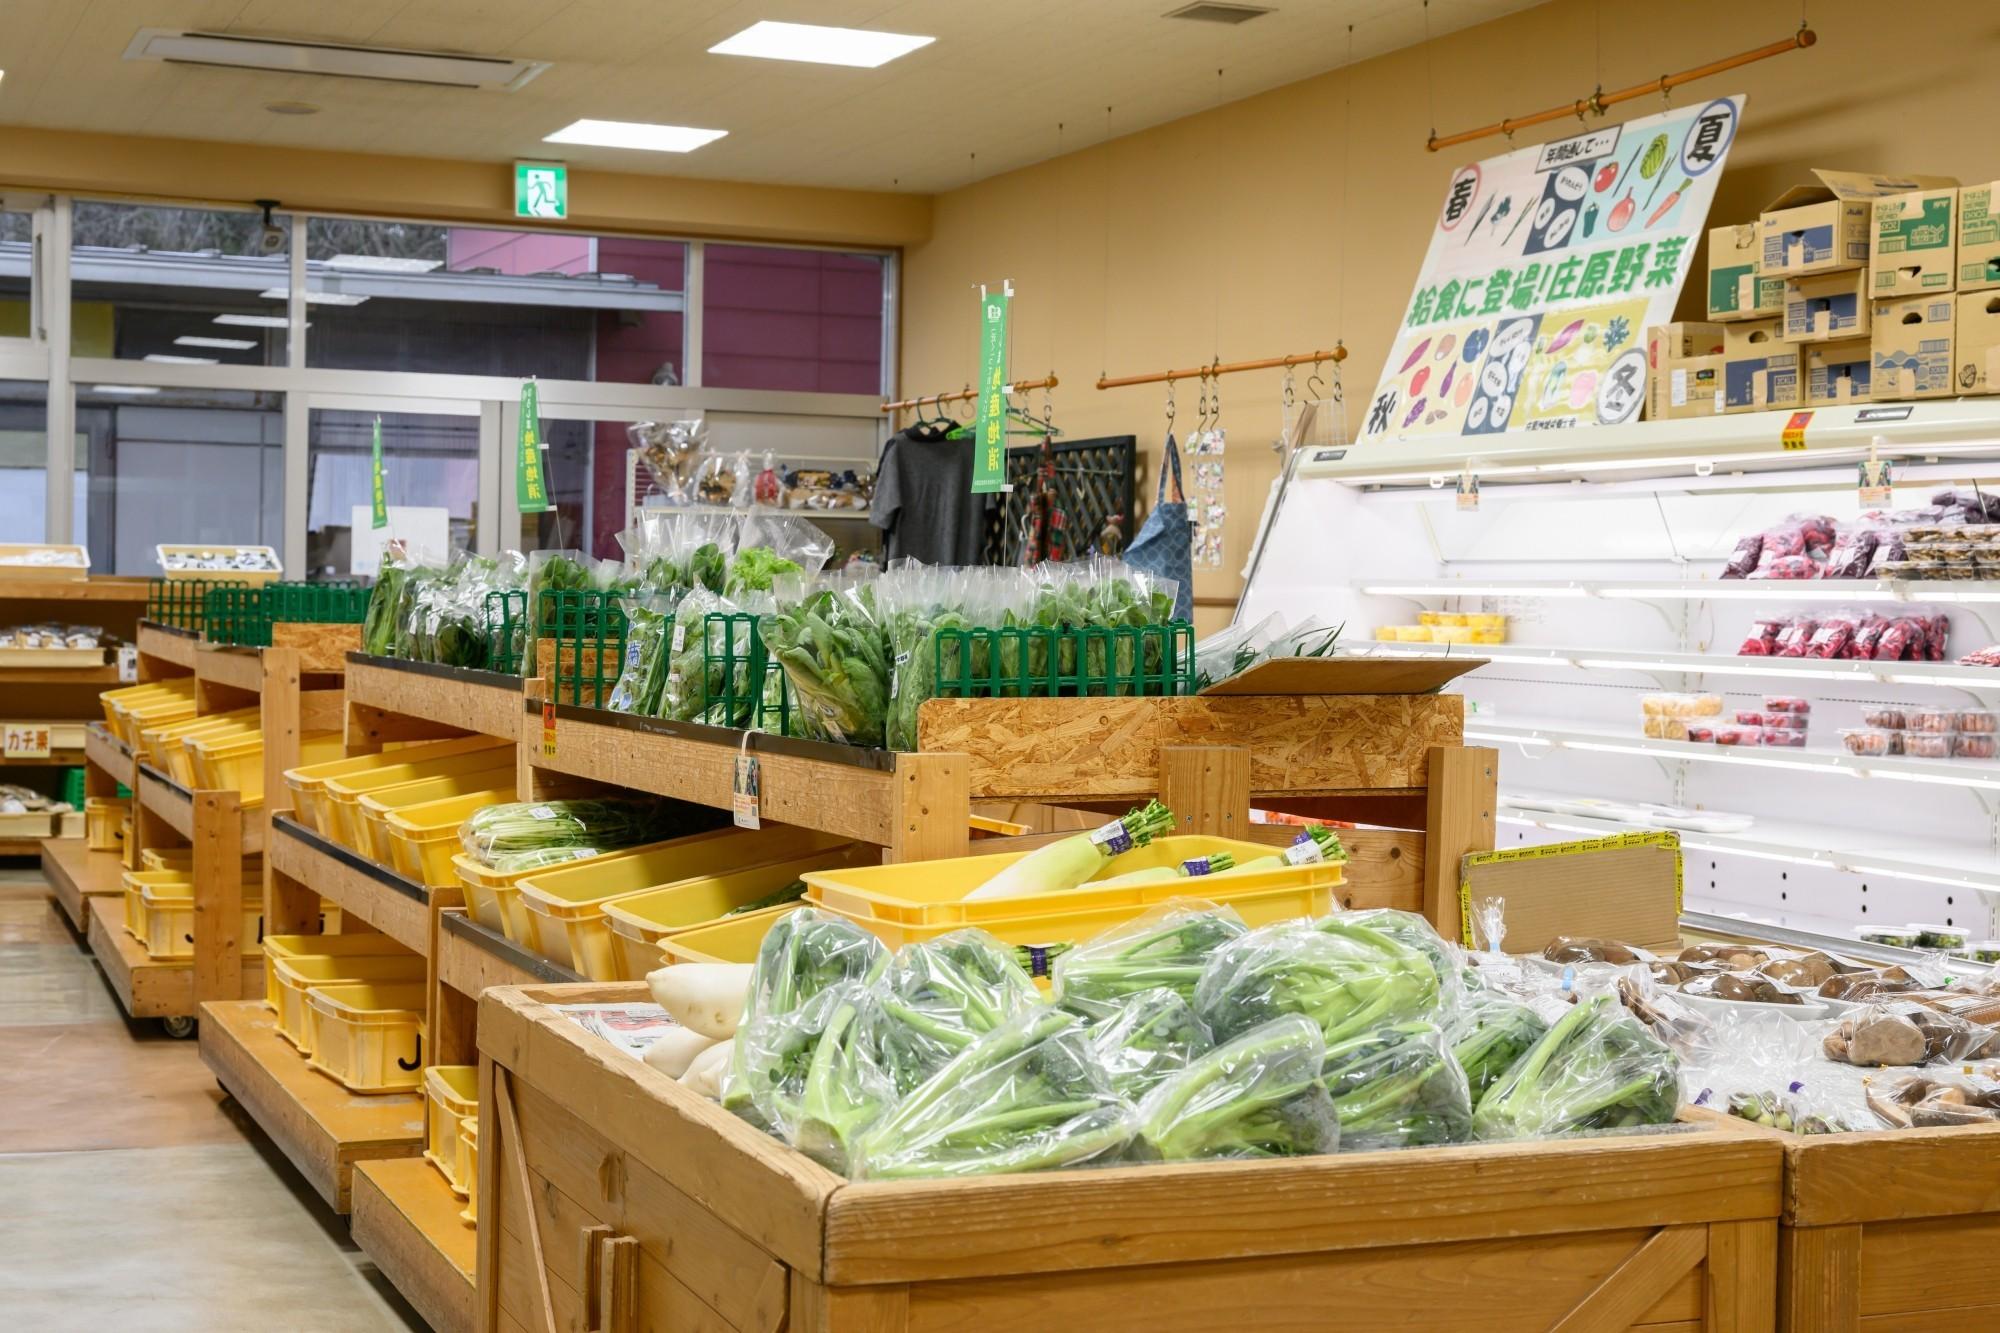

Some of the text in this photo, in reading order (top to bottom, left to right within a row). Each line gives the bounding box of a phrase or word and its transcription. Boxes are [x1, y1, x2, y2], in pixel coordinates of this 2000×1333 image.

[1687, 112, 1731, 162] 夏
[1443, 177, 1476, 223] 春
[1407, 235, 1689, 327] 給食に登場！庄原野菜
[1604, 363, 1639, 412] 冬
[1366, 388, 1396, 436] 秋
[8, 730, 48, 752] カチ栗
